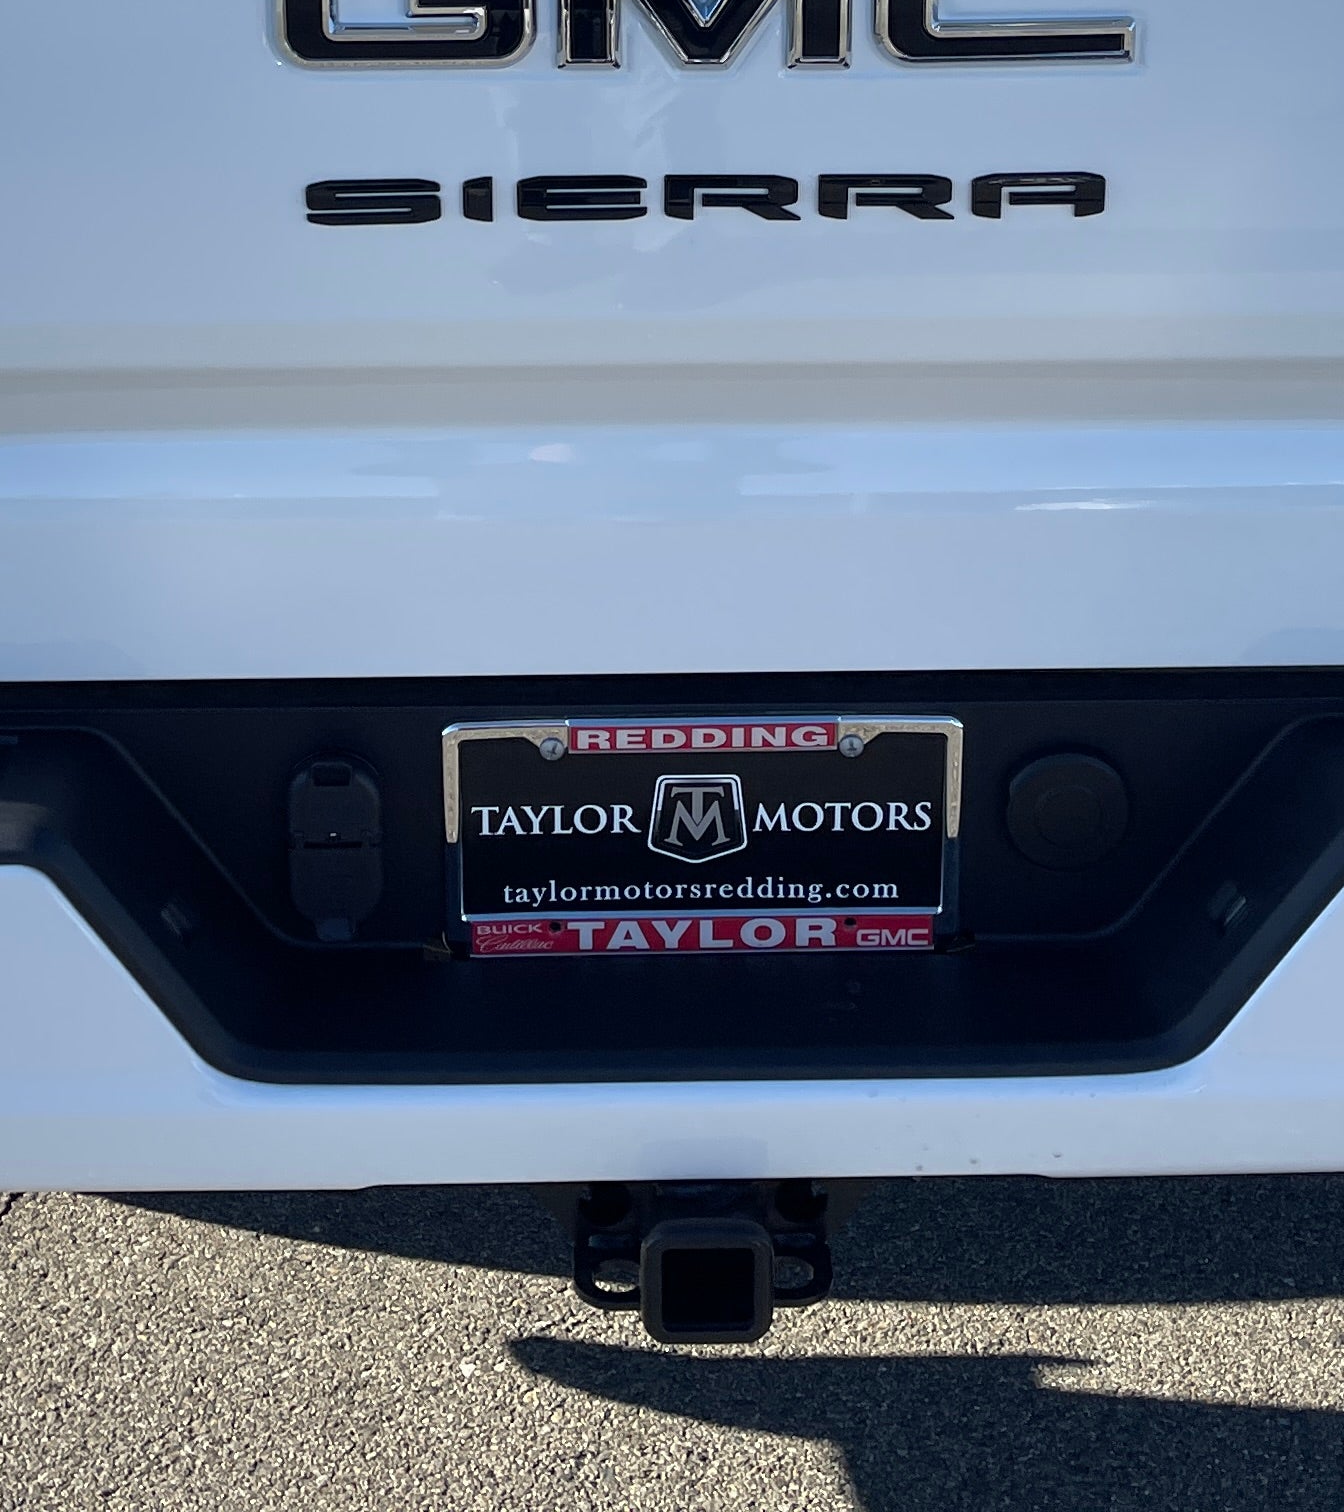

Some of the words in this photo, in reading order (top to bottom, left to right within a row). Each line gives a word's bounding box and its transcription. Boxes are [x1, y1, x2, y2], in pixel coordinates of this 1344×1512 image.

[304, 171, 1107, 226] SIERRA
[575, 726, 831, 750] REDDING
[471, 804, 643, 836] TAYLOR
[753, 801, 933, 833] MOTORS
[503, 877, 899, 907] taylormotorsredding.com
[477, 924, 543, 935] BUICK
[567, 917, 838, 950] TAYLOR
[856, 928, 930, 947] GMC
[476, 934, 554, 953] Cadillac
